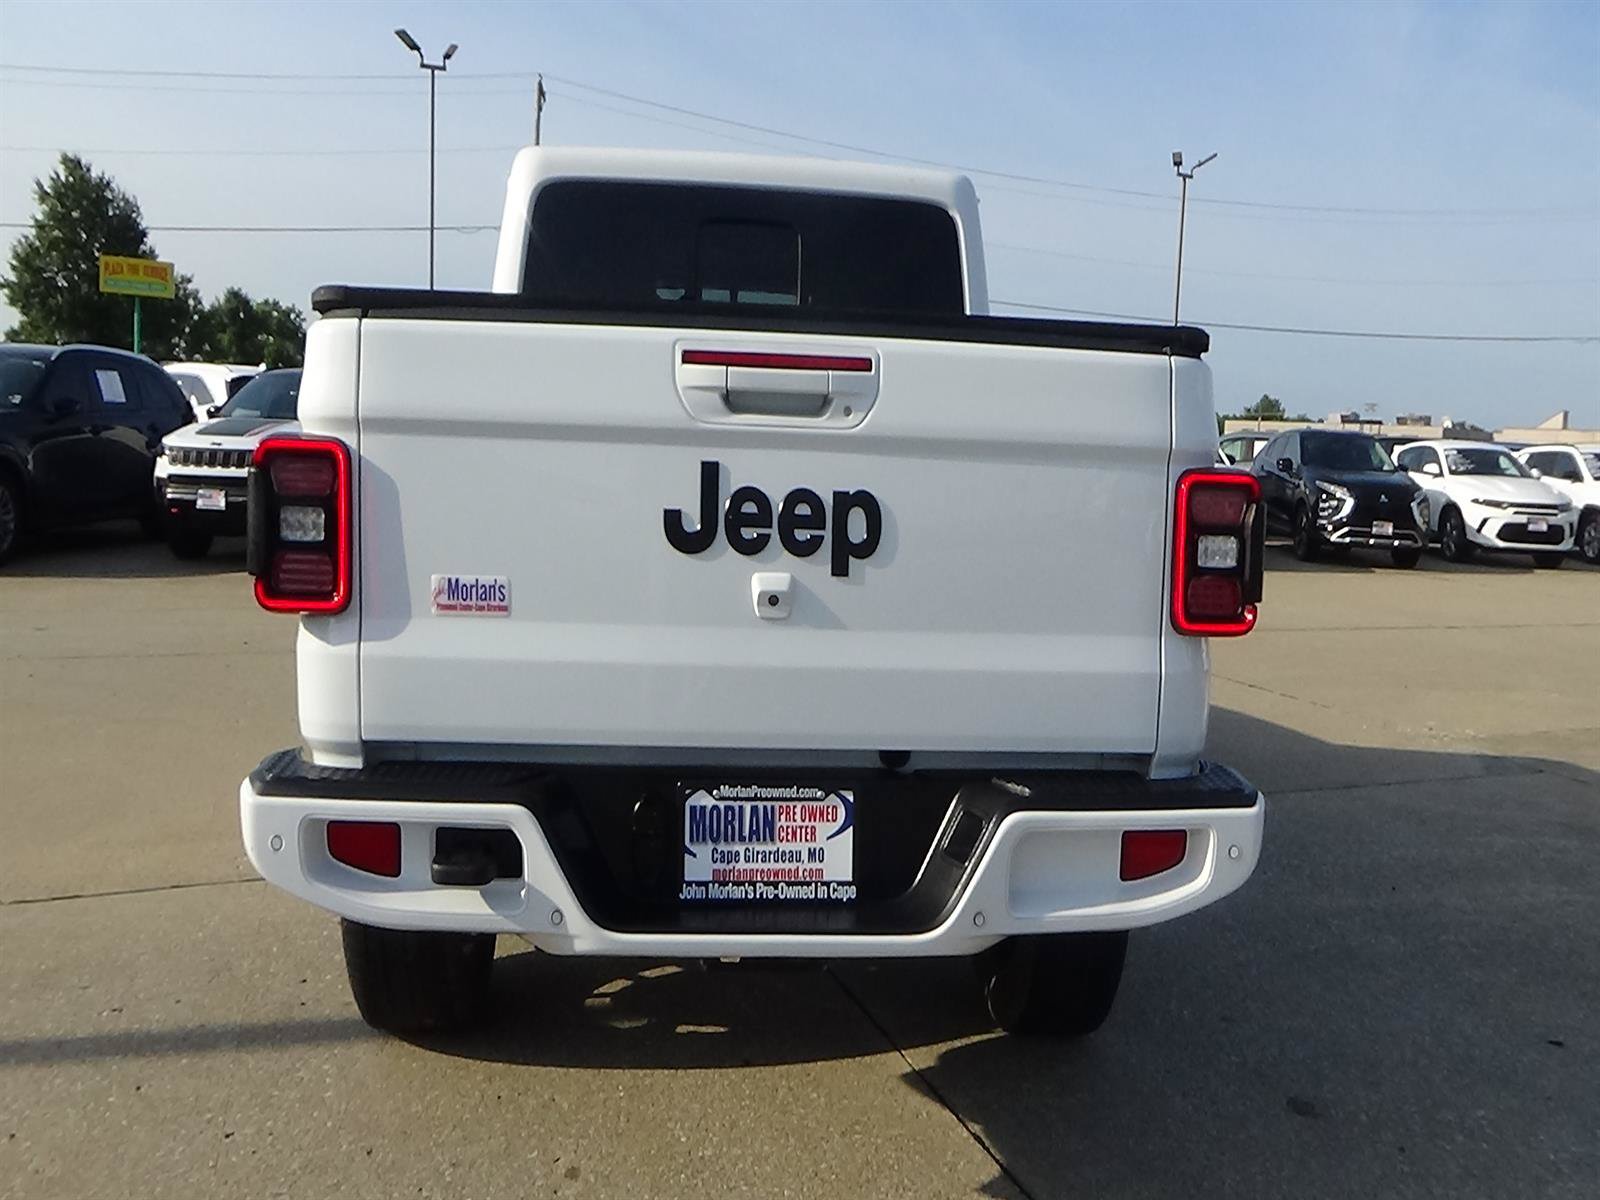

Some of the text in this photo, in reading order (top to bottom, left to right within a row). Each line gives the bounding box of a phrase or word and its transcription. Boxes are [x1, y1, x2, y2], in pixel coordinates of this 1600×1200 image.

[664, 460, 882, 577] Jeep
[447, 577, 506, 602] Morlan's
[720, 785, 819, 799] MorlanPreowned.com
[778, 804, 838, 823] PRE OWNED
[689, 804, 776, 843] MORLAN
[777, 825, 817, 843] CENTER
[711, 847, 825, 865] Cape Girardeau, MO
[712, 865, 824, 881] morlanpreowned.com
[679, 882, 857, 902] John Morlan's Pre-Owned in Cape
